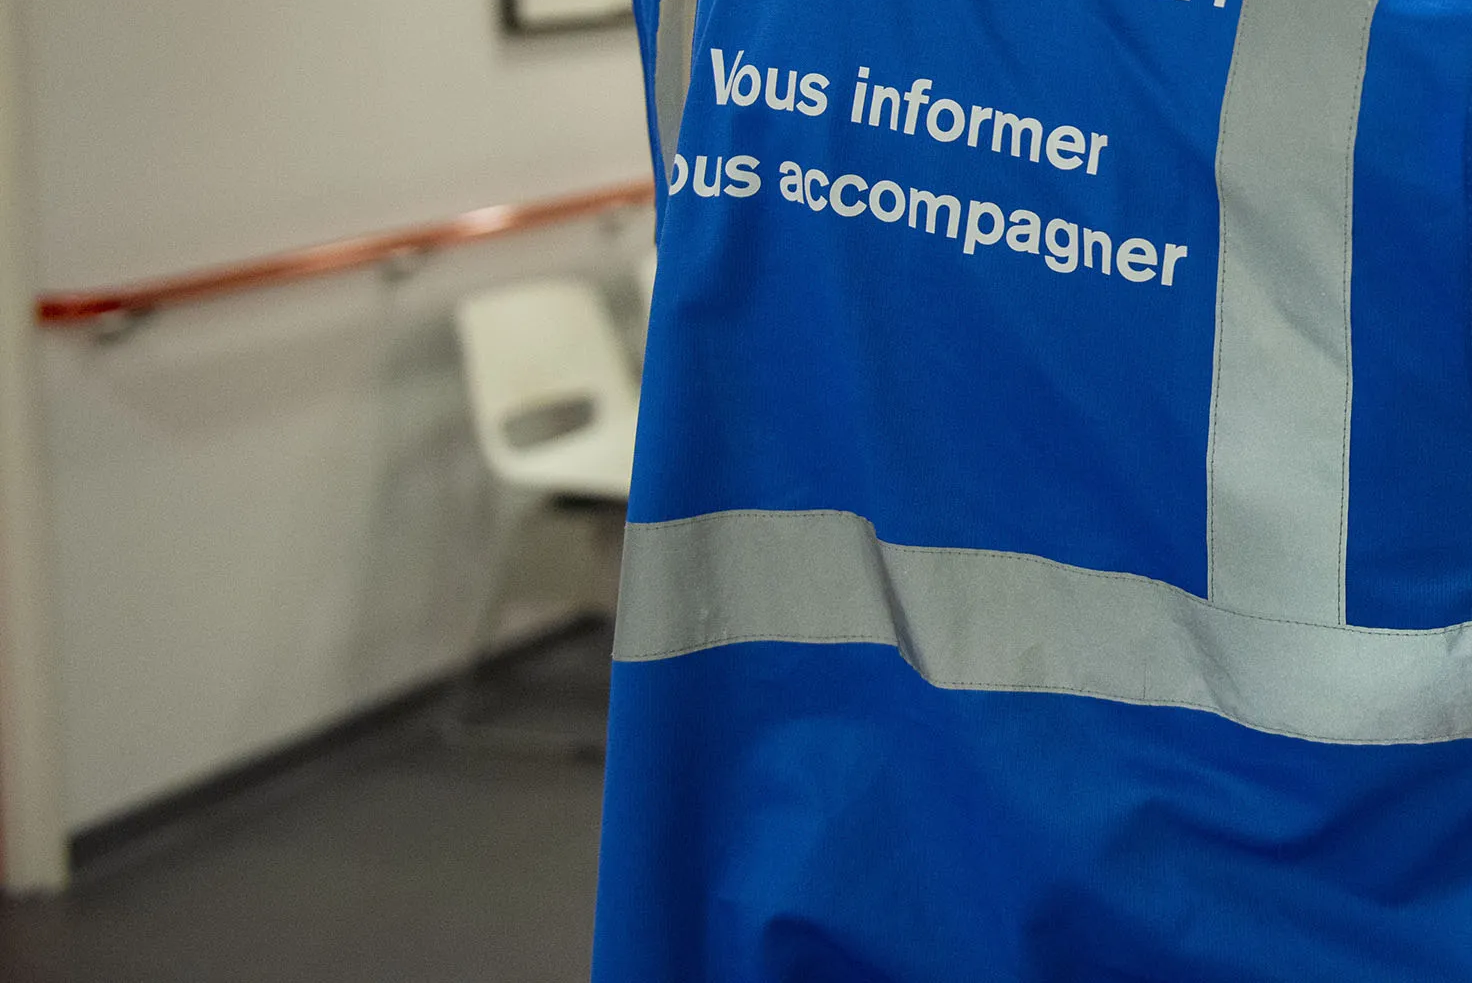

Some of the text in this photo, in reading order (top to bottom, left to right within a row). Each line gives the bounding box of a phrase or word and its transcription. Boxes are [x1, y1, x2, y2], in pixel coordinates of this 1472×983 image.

[710, 48, 1109, 176] Vous informer
[779, 160, 1188, 287] accompagner
